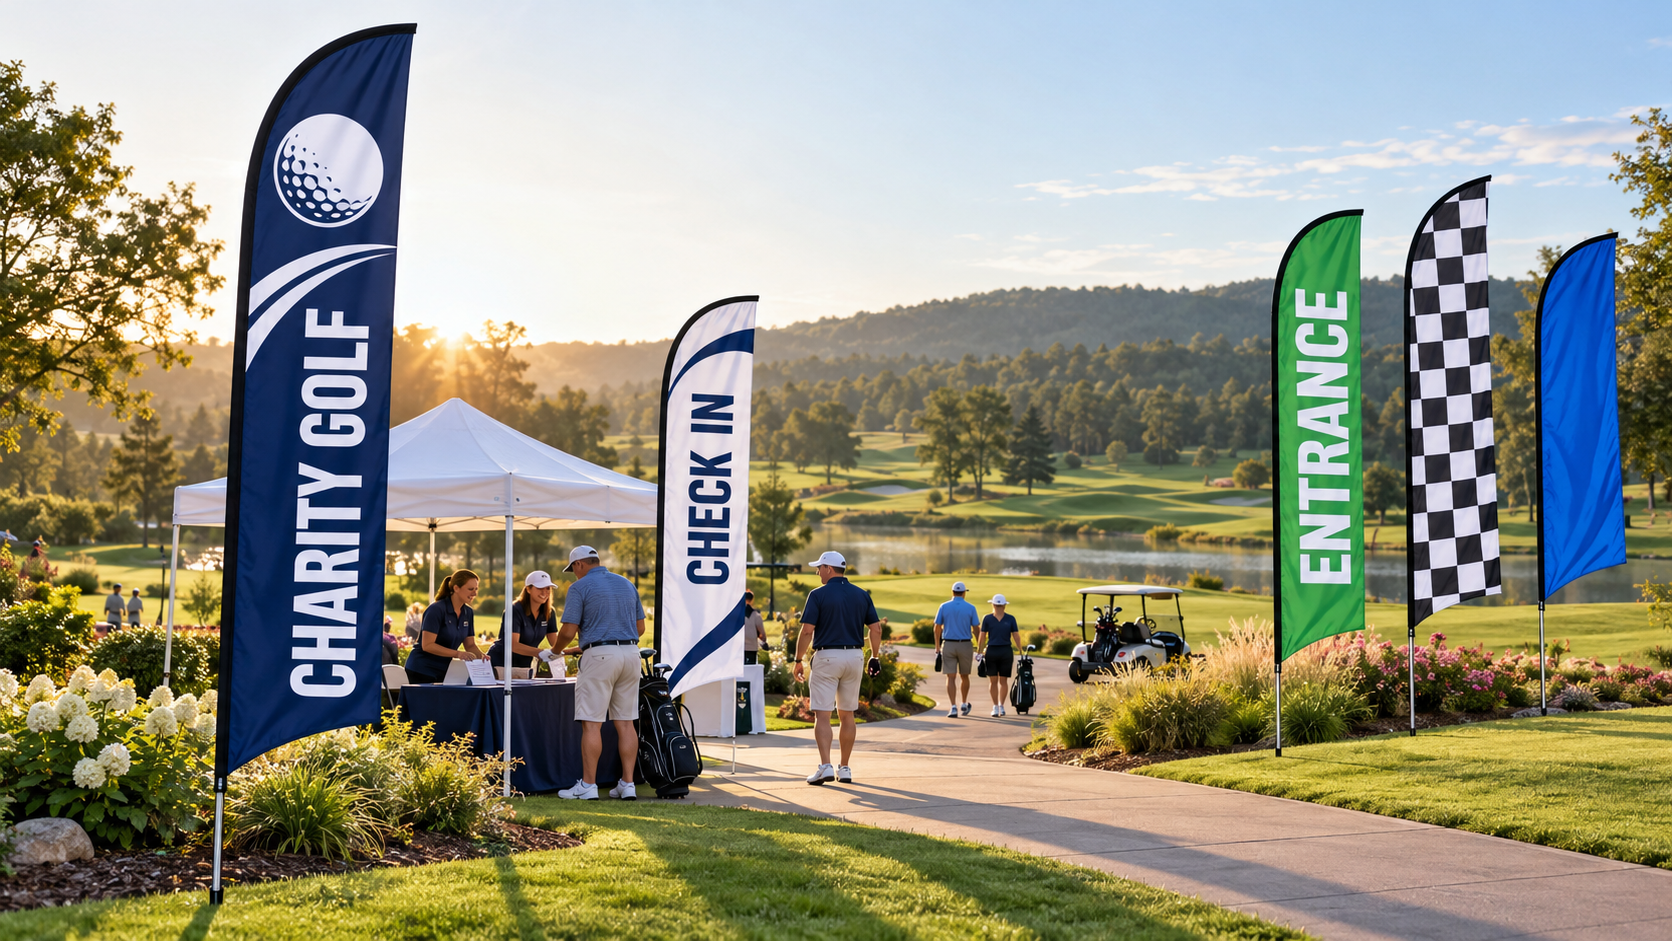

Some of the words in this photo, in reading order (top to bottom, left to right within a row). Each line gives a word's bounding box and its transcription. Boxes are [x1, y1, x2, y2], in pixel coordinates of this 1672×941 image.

[298, 307, 370, 447] GOLF
[690, 393, 735, 435] IN
[1294, 288, 1352, 585] ENTRANCE
[289, 462, 363, 698] CHARITY
[686, 450, 732, 585] CHECK
